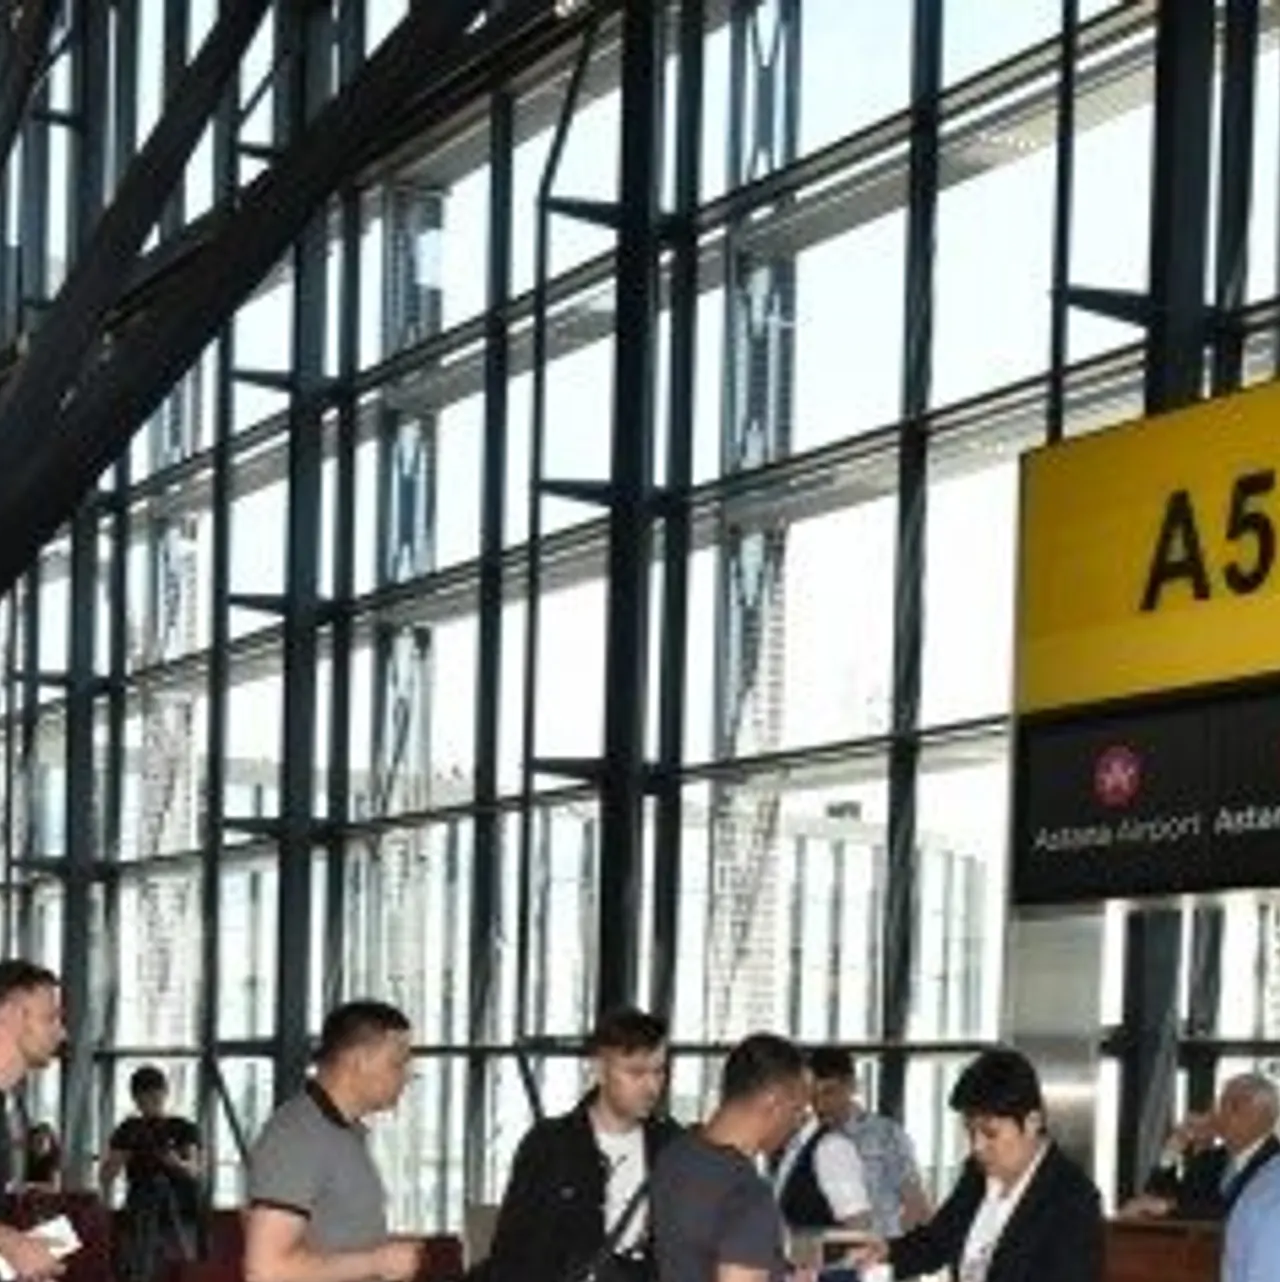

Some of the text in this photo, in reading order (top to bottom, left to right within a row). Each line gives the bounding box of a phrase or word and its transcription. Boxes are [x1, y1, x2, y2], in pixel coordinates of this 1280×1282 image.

[1138, 470, 1277, 612] A5
[1034, 813, 1202, 852] Astana Airport
